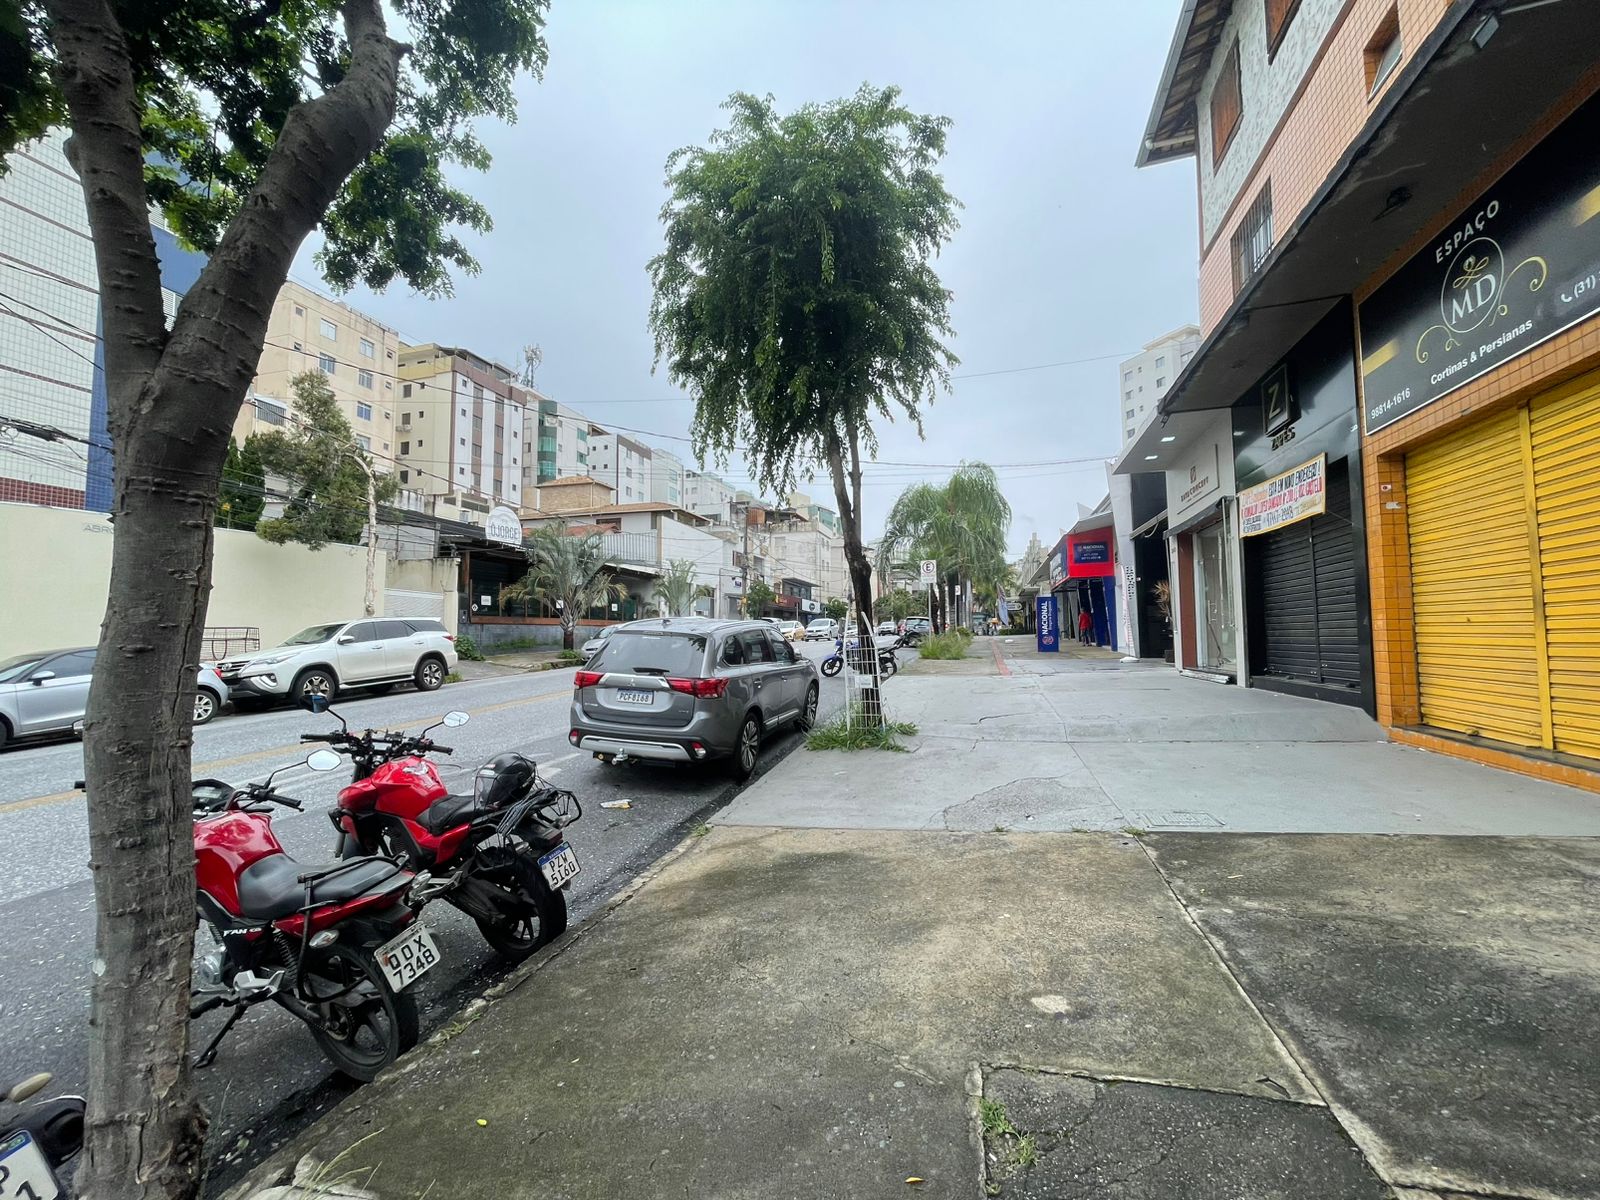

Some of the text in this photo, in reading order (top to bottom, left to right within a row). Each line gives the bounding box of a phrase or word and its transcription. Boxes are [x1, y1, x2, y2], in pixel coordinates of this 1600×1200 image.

[1436, 200, 1499, 263] ESPAÇO
[1450, 273, 1496, 325] MD
[1574, 274, 1596, 298] (31)
[1430, 319, 1533, 385] Cortinas & Persianas
[1370, 388, 1411, 420] 98814-1616
[549, 852, 568, 872] PZW
[223, 928, 248, 937] FAN
[392, 948, 435, 986] 7348
